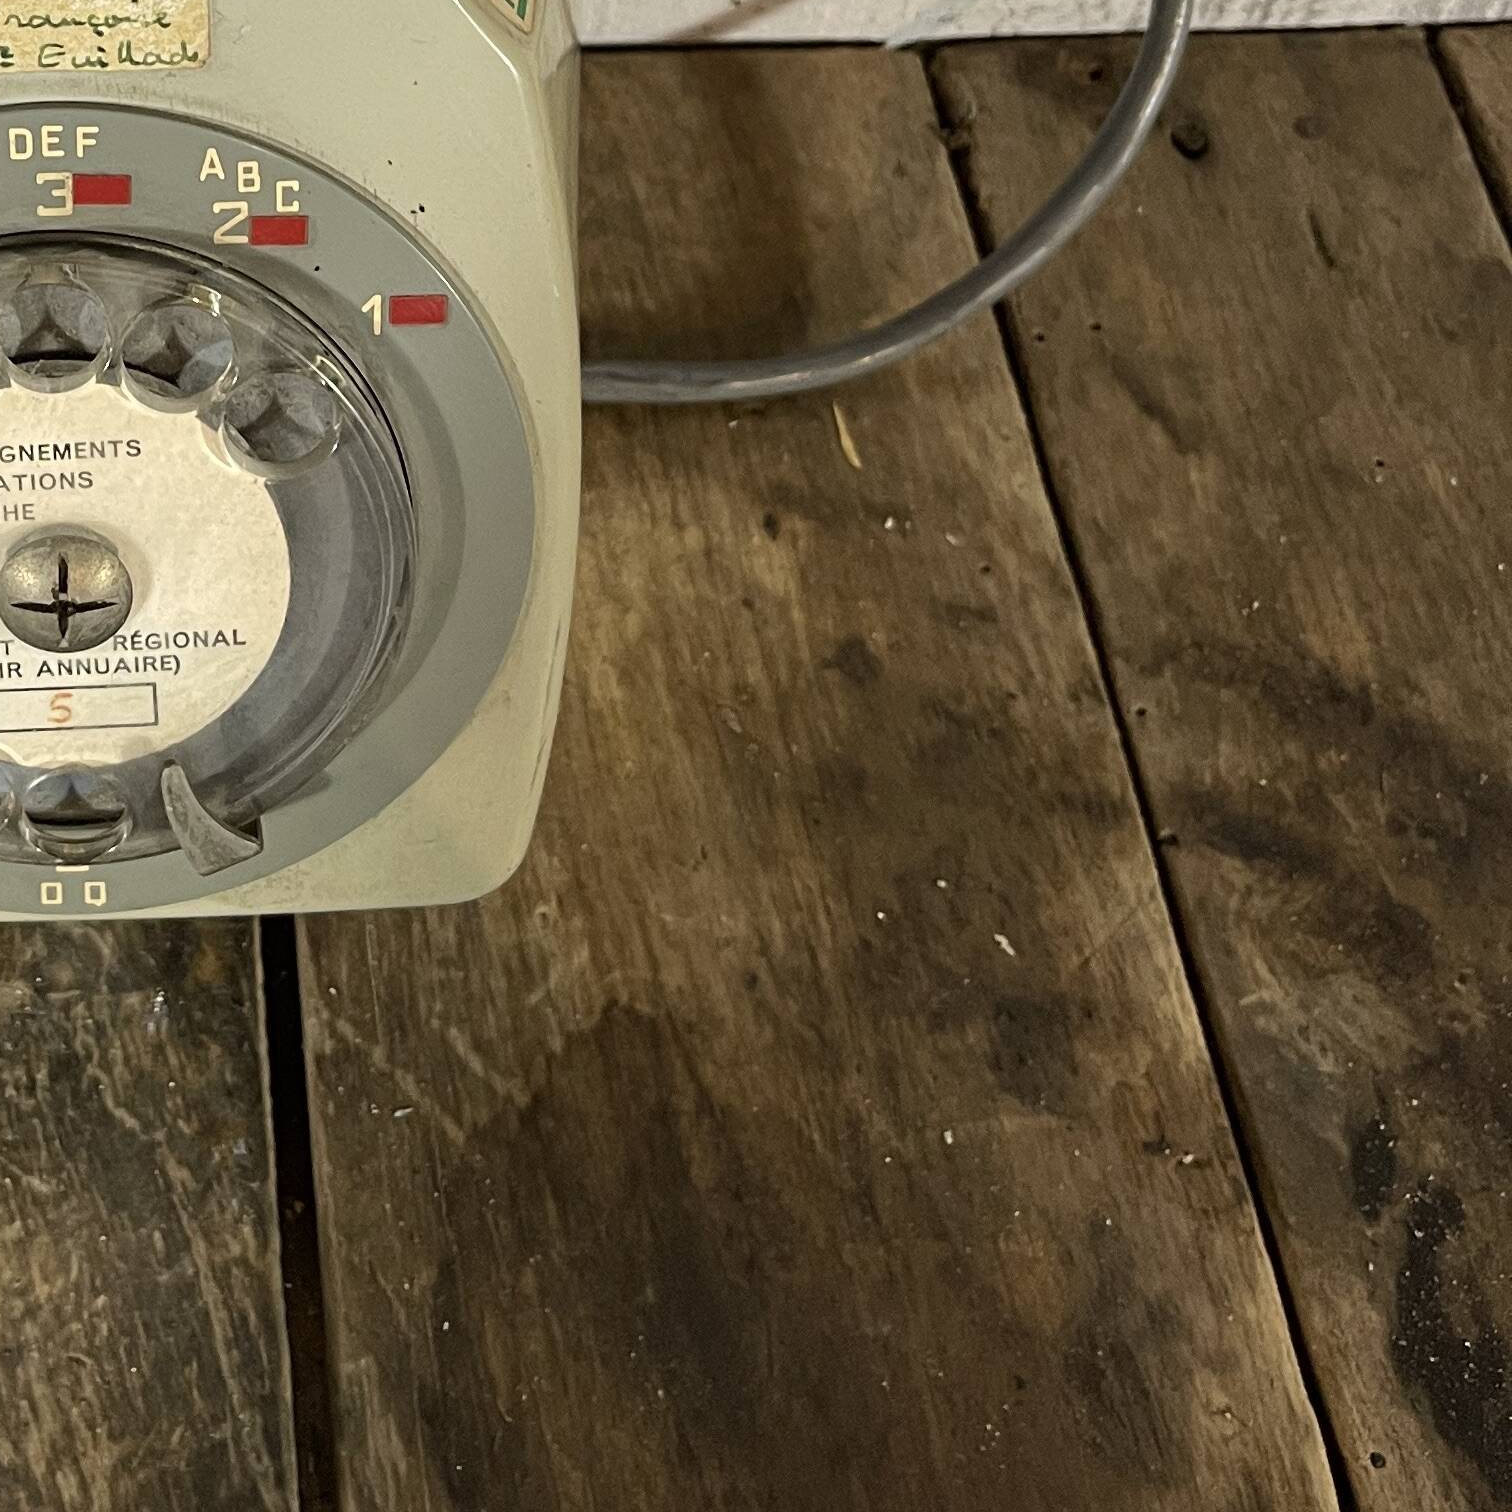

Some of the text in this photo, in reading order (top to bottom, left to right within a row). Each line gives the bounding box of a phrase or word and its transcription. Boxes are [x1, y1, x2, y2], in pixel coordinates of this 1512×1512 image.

[8, 124, 100, 161] DEF
[35, 171, 74, 217] 3
[212, 200, 249, 245] 2
[360, 294, 382, 336] 1
[112, 629, 247, 653] RÉGIONAL
[37, 655, 182, 678] ANNUAIRE)
[46, 692, 75, 724] 5
